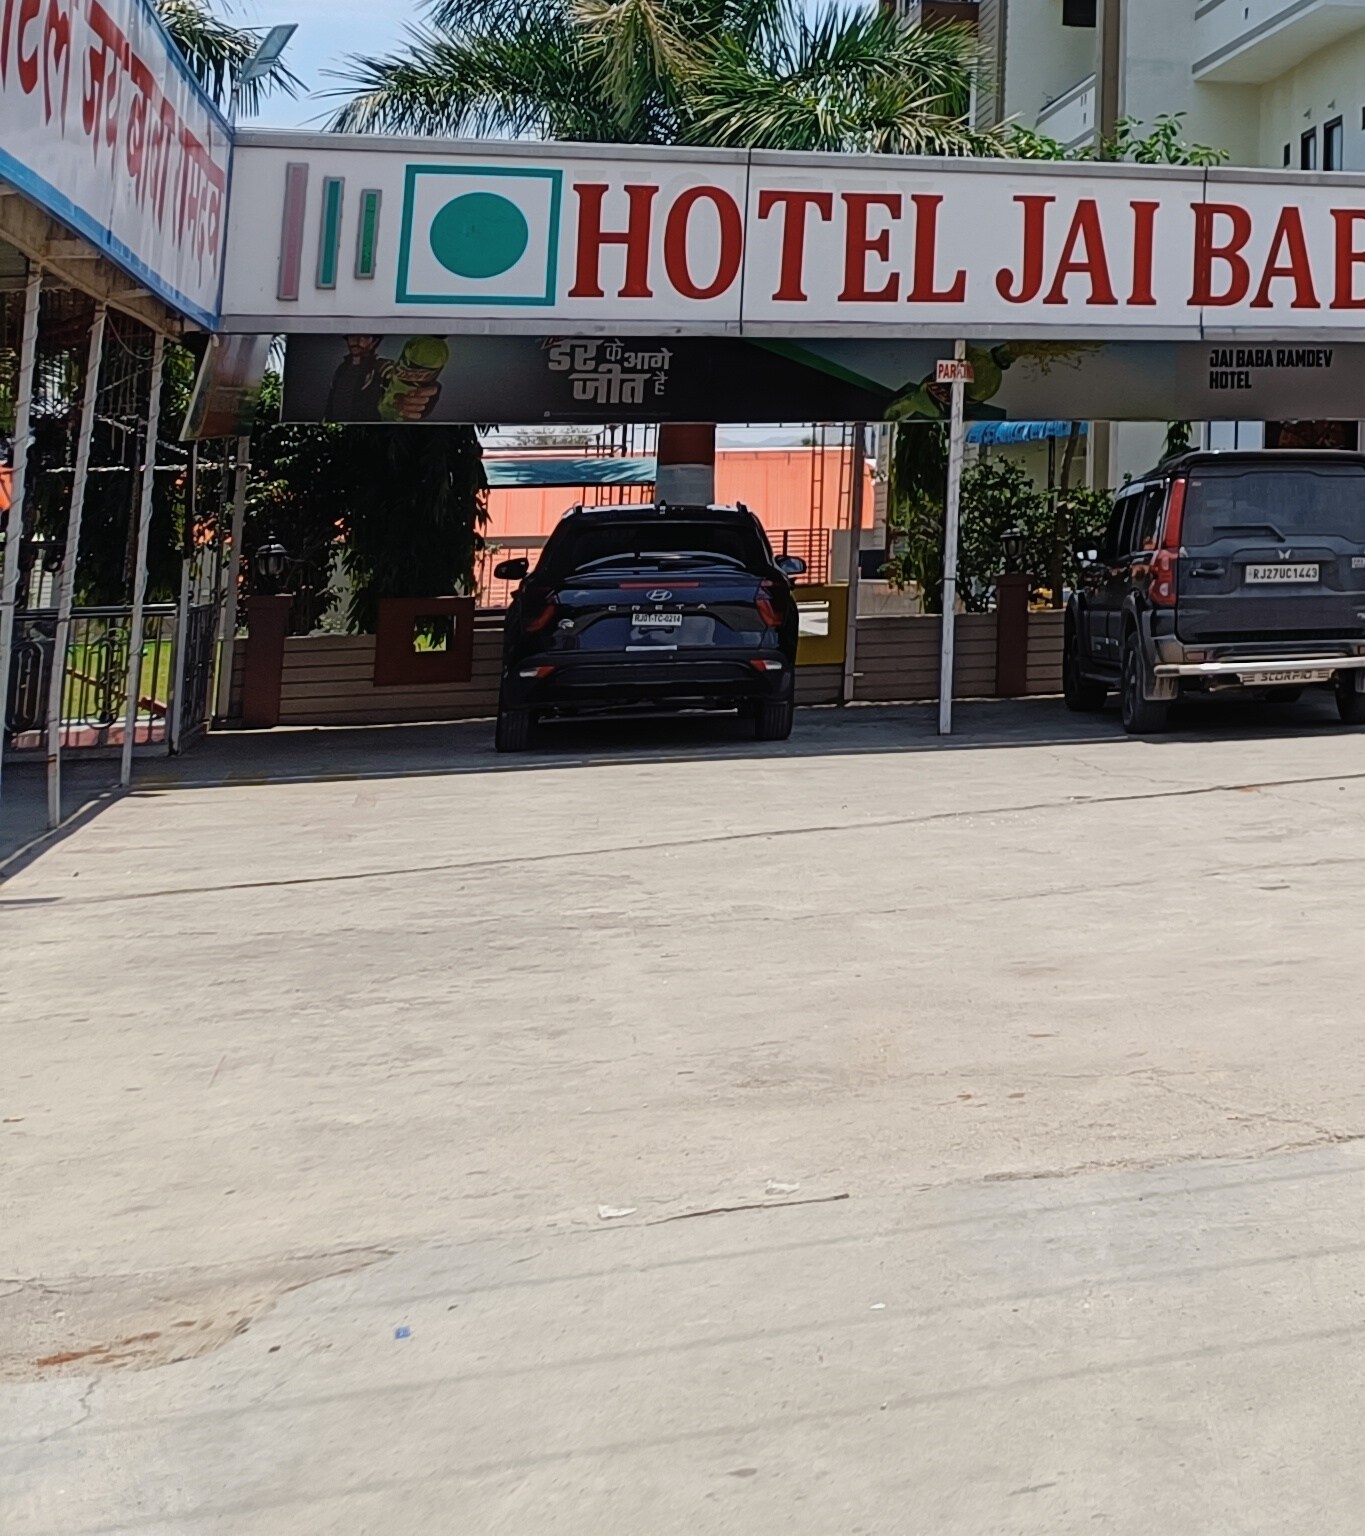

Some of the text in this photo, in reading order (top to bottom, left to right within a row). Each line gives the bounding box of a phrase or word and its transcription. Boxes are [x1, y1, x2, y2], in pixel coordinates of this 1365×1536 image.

[568, 184, 966, 304] HOTEL
[995, 195, 1158, 306] JAI
[549, 339, 605, 371] डर
[604, 338, 624, 362] के
[624, 348, 674, 370] आगे
[1210, 350, 1333, 368] JAI BABA RAMDEV
[568, 363, 668, 404] जीत है
[1209, 371, 1252, 389] HOTEL
[1253, 567, 1318, 580] RJ27UC1443
[608, 603, 707, 612] CRETA
[1261, 671, 1313, 682] SCORPIO
